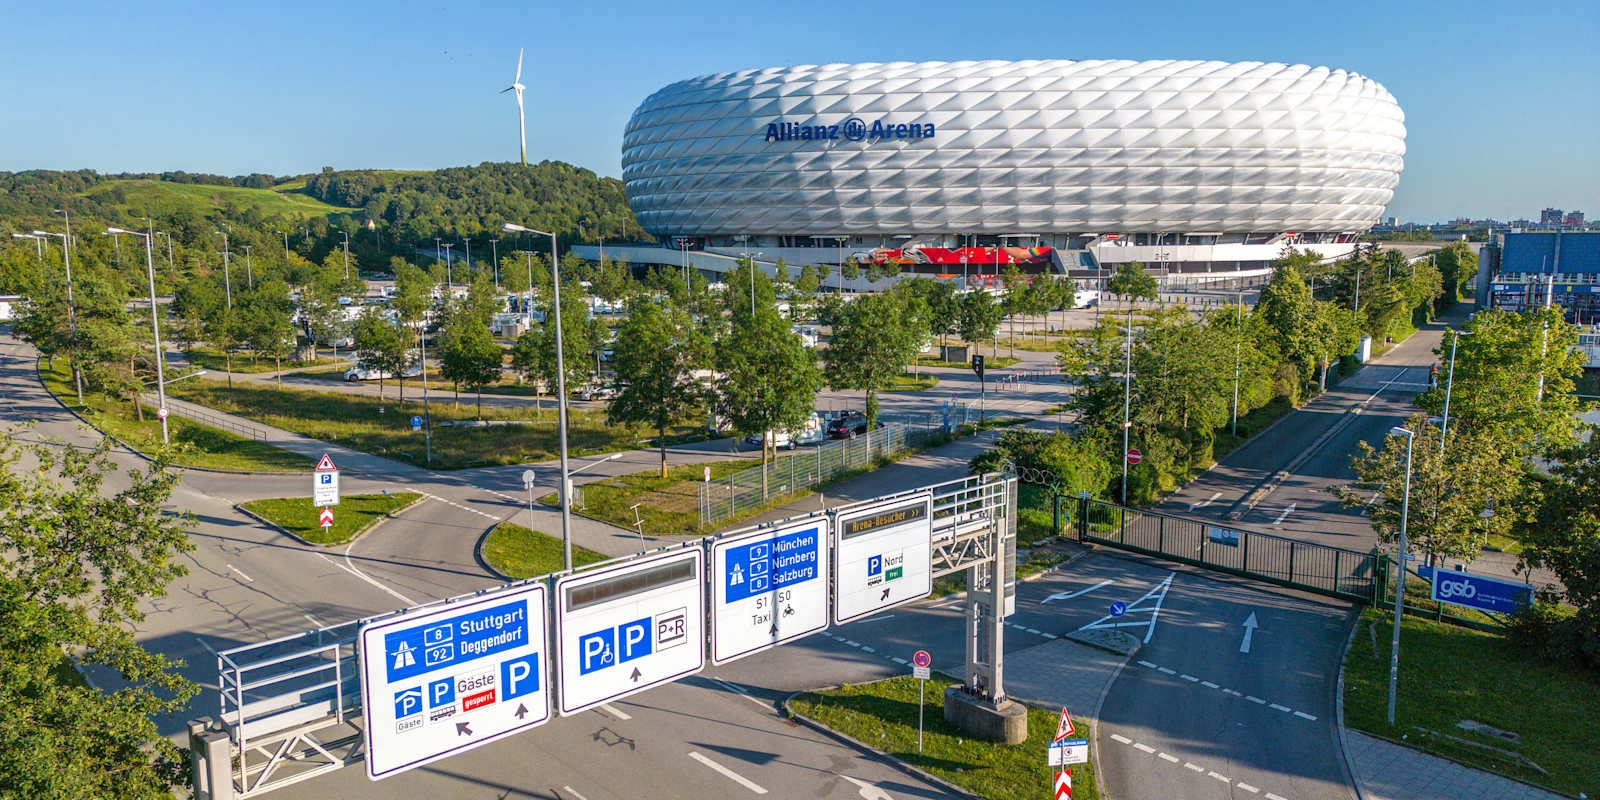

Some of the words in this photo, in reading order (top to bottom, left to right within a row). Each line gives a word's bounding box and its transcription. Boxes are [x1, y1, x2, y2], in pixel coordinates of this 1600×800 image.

[765, 122, 839, 142] Allianz
[870, 119, 935, 139] Arena
[323, 475, 330, 483] P
[852, 511, 906, 532] Arena-Besucher
[772, 535, 814, 553] München
[772, 550, 816, 569] Nürnberg
[870, 558, 879, 574] P
[884, 554, 904, 567] Nord
[756, 579, 762, 588] 8
[772, 566, 813, 585] Salzburg
[1439, 579, 1477, 599] gsb
[756, 596, 767, 610] S1
[434, 629, 443, 641] 8
[460, 607, 524, 636] Stuttgart
[752, 610, 771, 626] Taxi
[658, 619, 684, 640] P+R
[432, 647, 448, 661] 92
[460, 626, 523, 656] Deggendorf
[626, 624, 645, 657] P
[584, 636, 604, 670] P
[509, 660, 531, 695] P
[434, 682, 449, 704] P
[457, 674, 495, 694] Gäste
[402, 696, 416, 716] P
[464, 693, 494, 710] gesperrt
[398, 718, 422, 731] Gäste
